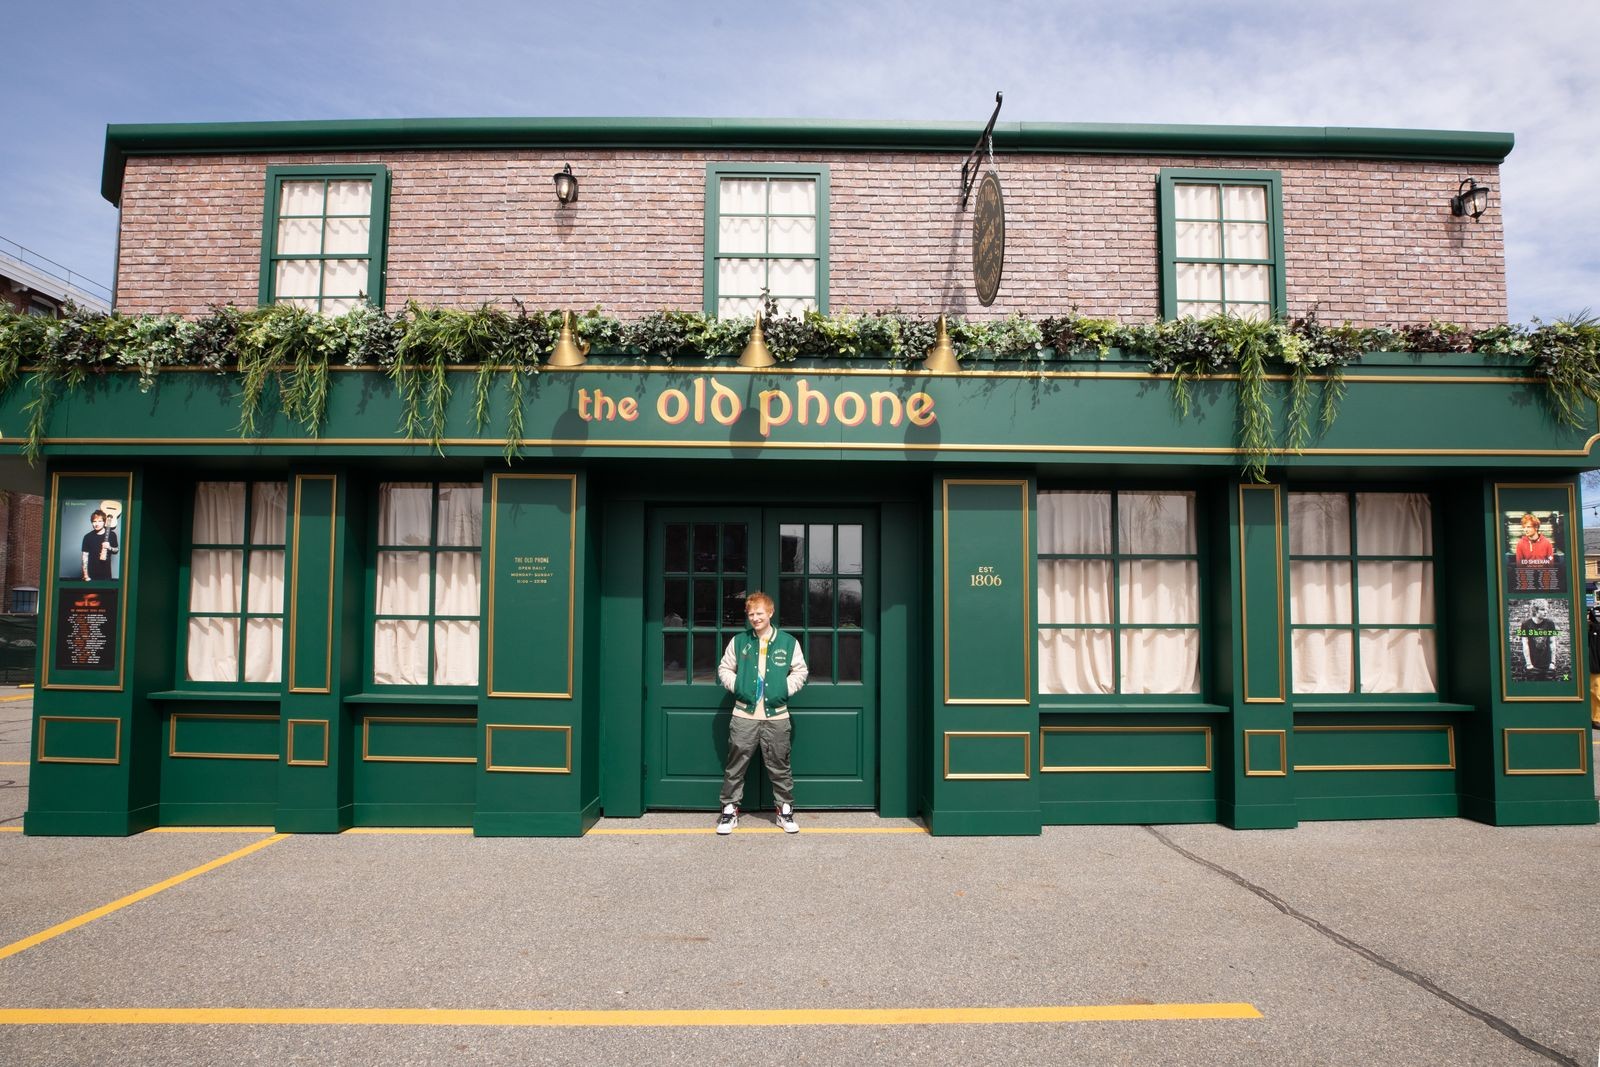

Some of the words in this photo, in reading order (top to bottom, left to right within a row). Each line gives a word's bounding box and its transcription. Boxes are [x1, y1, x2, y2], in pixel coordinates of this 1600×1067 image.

[578, 388, 640, 422] the
[656, 377, 742, 425] old
[759, 379, 936, 437] phone
[970, 574, 1002, 587] 1806
